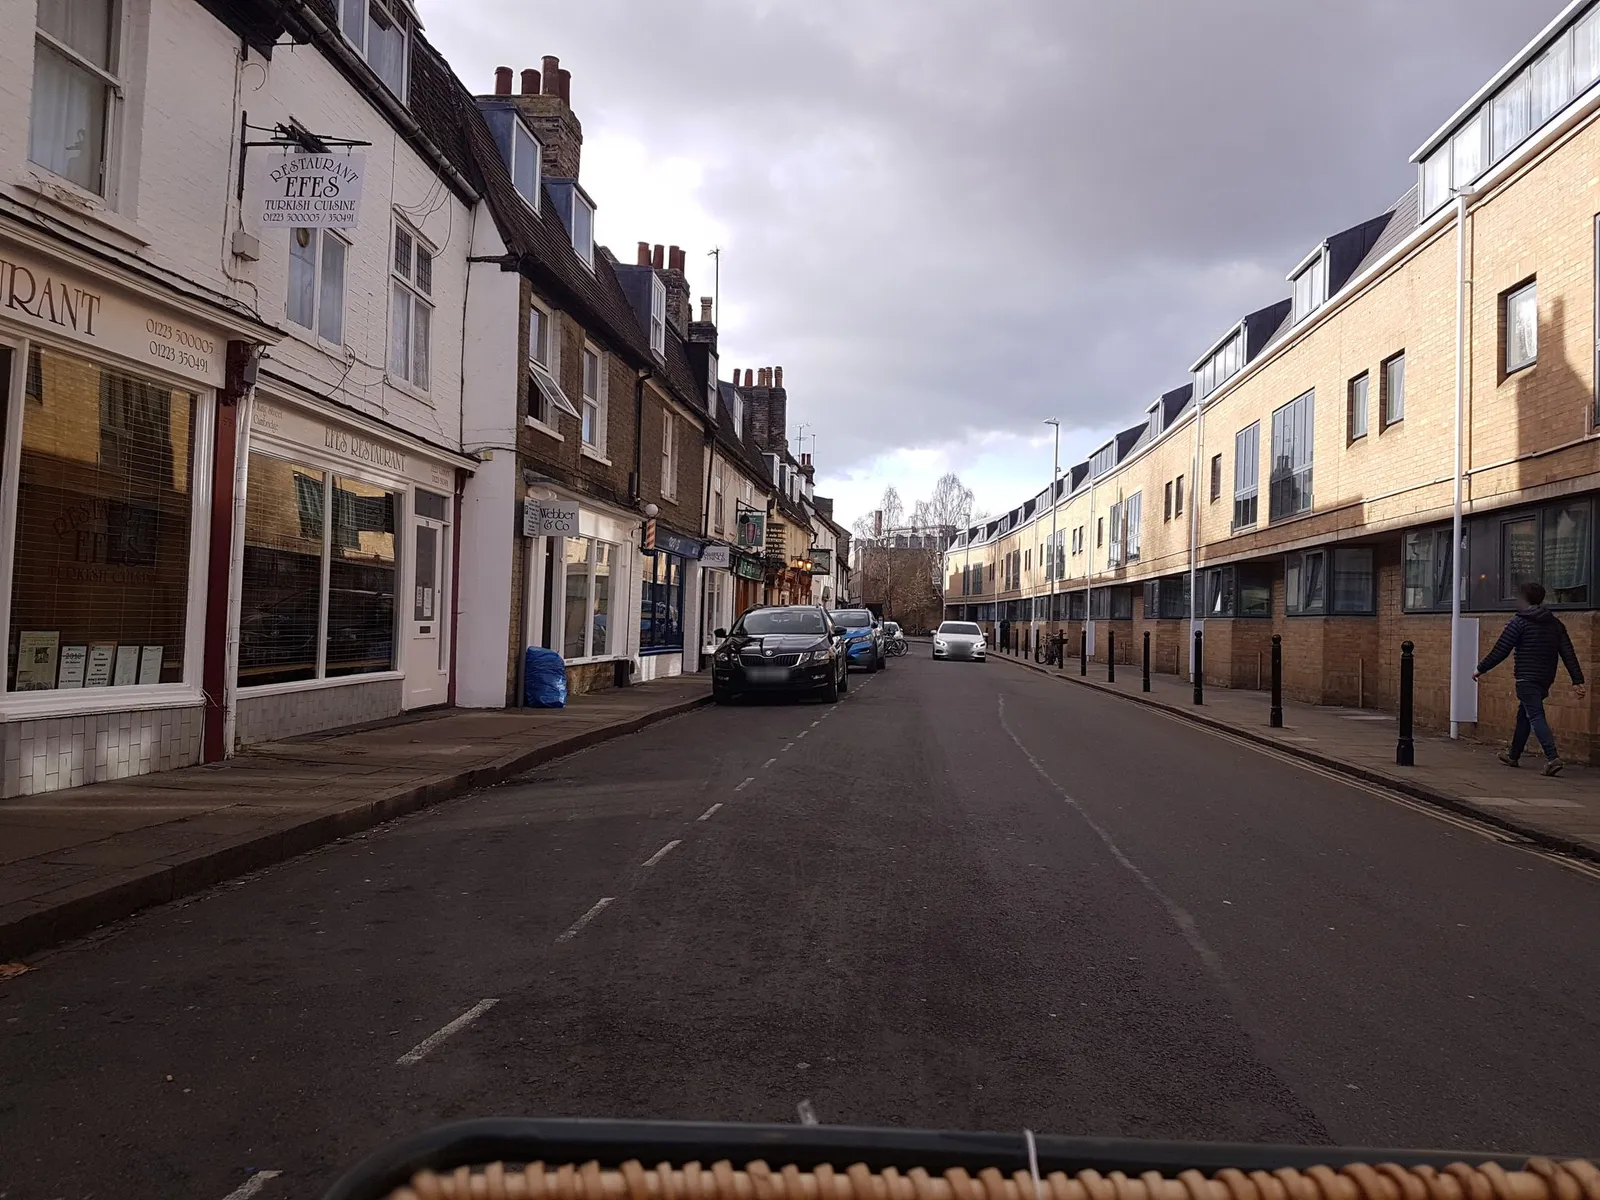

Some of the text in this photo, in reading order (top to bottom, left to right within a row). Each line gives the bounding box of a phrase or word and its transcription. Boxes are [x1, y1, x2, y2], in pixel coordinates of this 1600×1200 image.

[269, 157, 359, 184] RESTAURANT
[284, 175, 340, 198] EFES
[262, 212, 284, 222] 01223
[287, 212, 320, 222] 500005
[328, 213, 354, 222] 350491
[264, 200, 356, 211] TURKISH CUISINE
[145, 318, 215, 355] 01223 500005
[149, 340, 209, 374] 01223 350491
[324, 426, 348, 453] EFES
[351, 436, 406, 472] RESTAURANT
[539, 508, 576, 520] Webber
[543, 519, 570, 532] & Co
